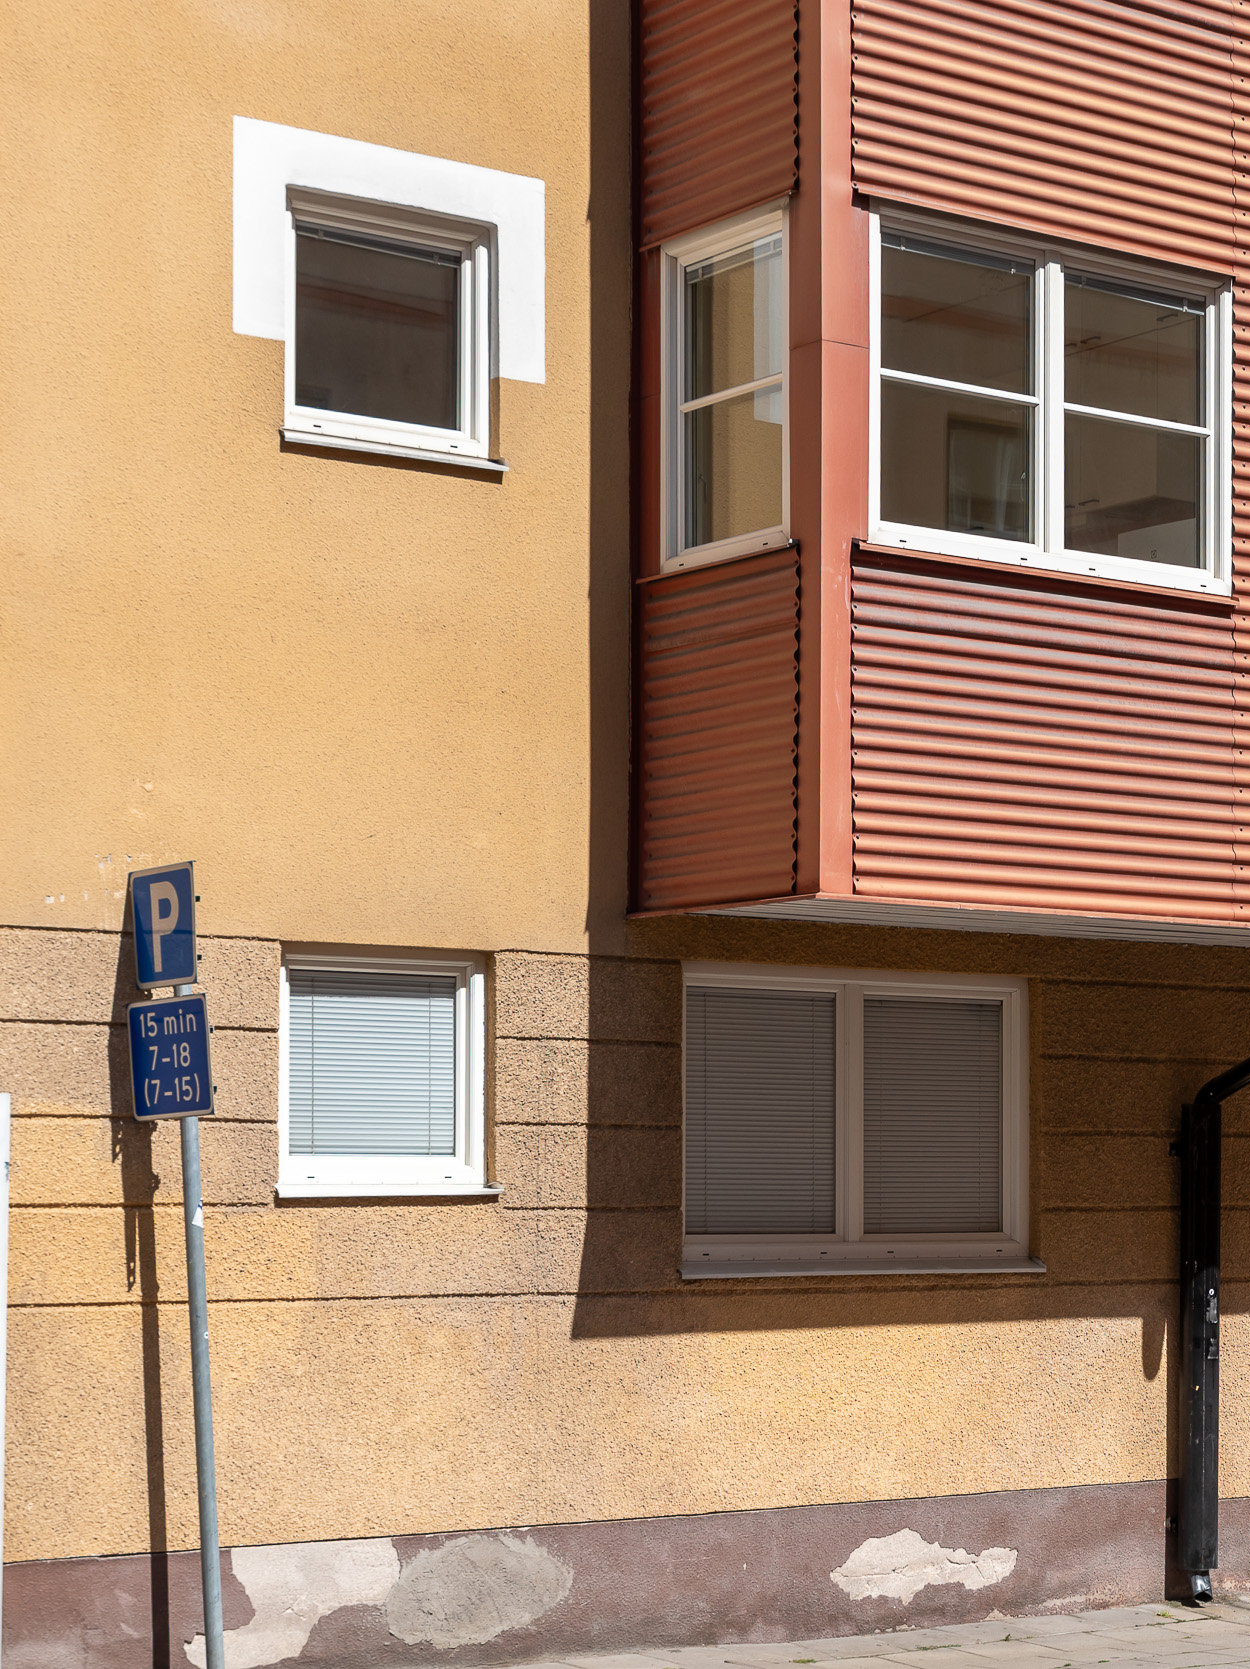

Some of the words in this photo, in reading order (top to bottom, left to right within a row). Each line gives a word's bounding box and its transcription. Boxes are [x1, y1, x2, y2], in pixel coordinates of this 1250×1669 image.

[149, 881, 179, 973] P
[140, 1012, 158, 1038] 15
[163, 1009, 197, 1035] min
[149, 1042, 191, 1071] 7-18
[144, 1073, 200, 1108] (7-15)
